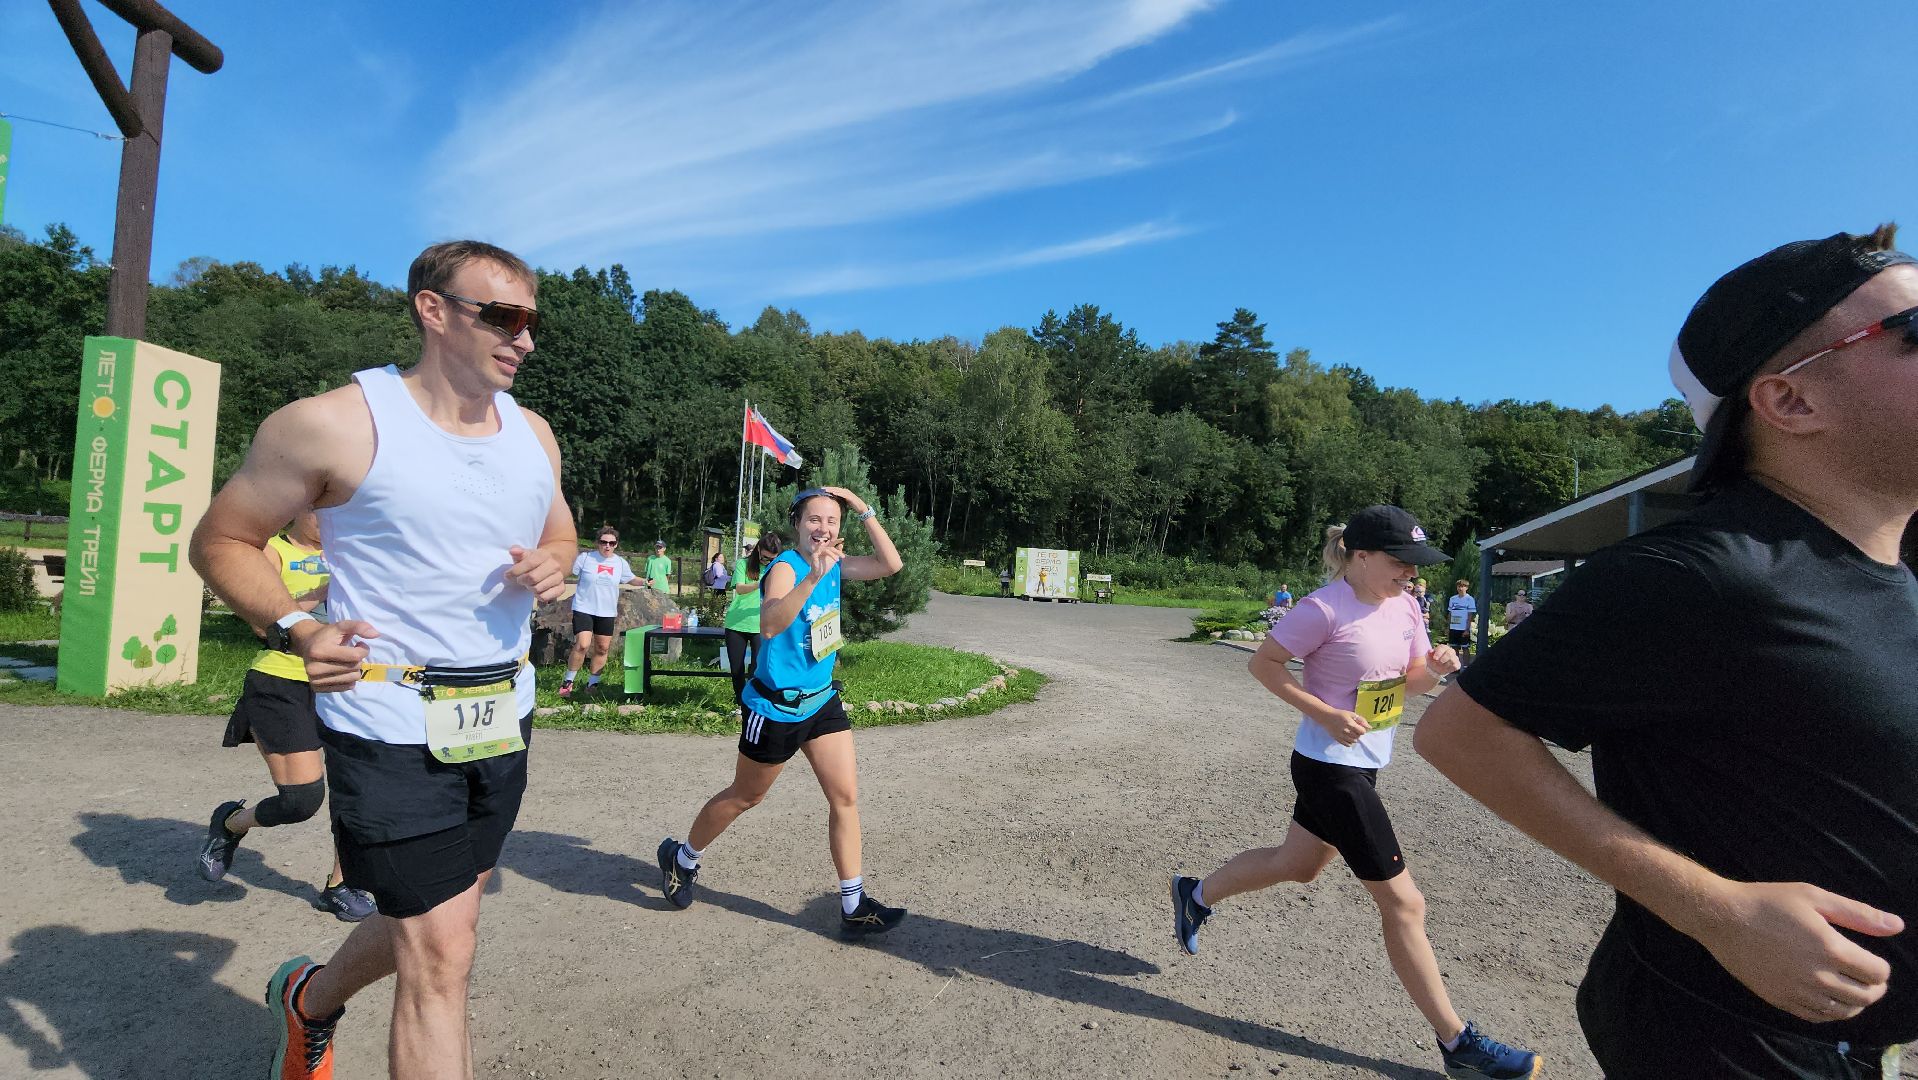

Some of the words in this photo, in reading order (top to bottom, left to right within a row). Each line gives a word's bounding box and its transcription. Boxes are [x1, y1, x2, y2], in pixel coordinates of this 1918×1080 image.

[86, 436, 108, 513] ФЕРМА
[139, 369, 192, 573] СТАРТ
[80, 524, 101, 596] ТРЕЙЛ
[819, 622, 833, 641] 105
[453, 700, 496, 730] 115
[1373, 693, 1395, 714] 120
